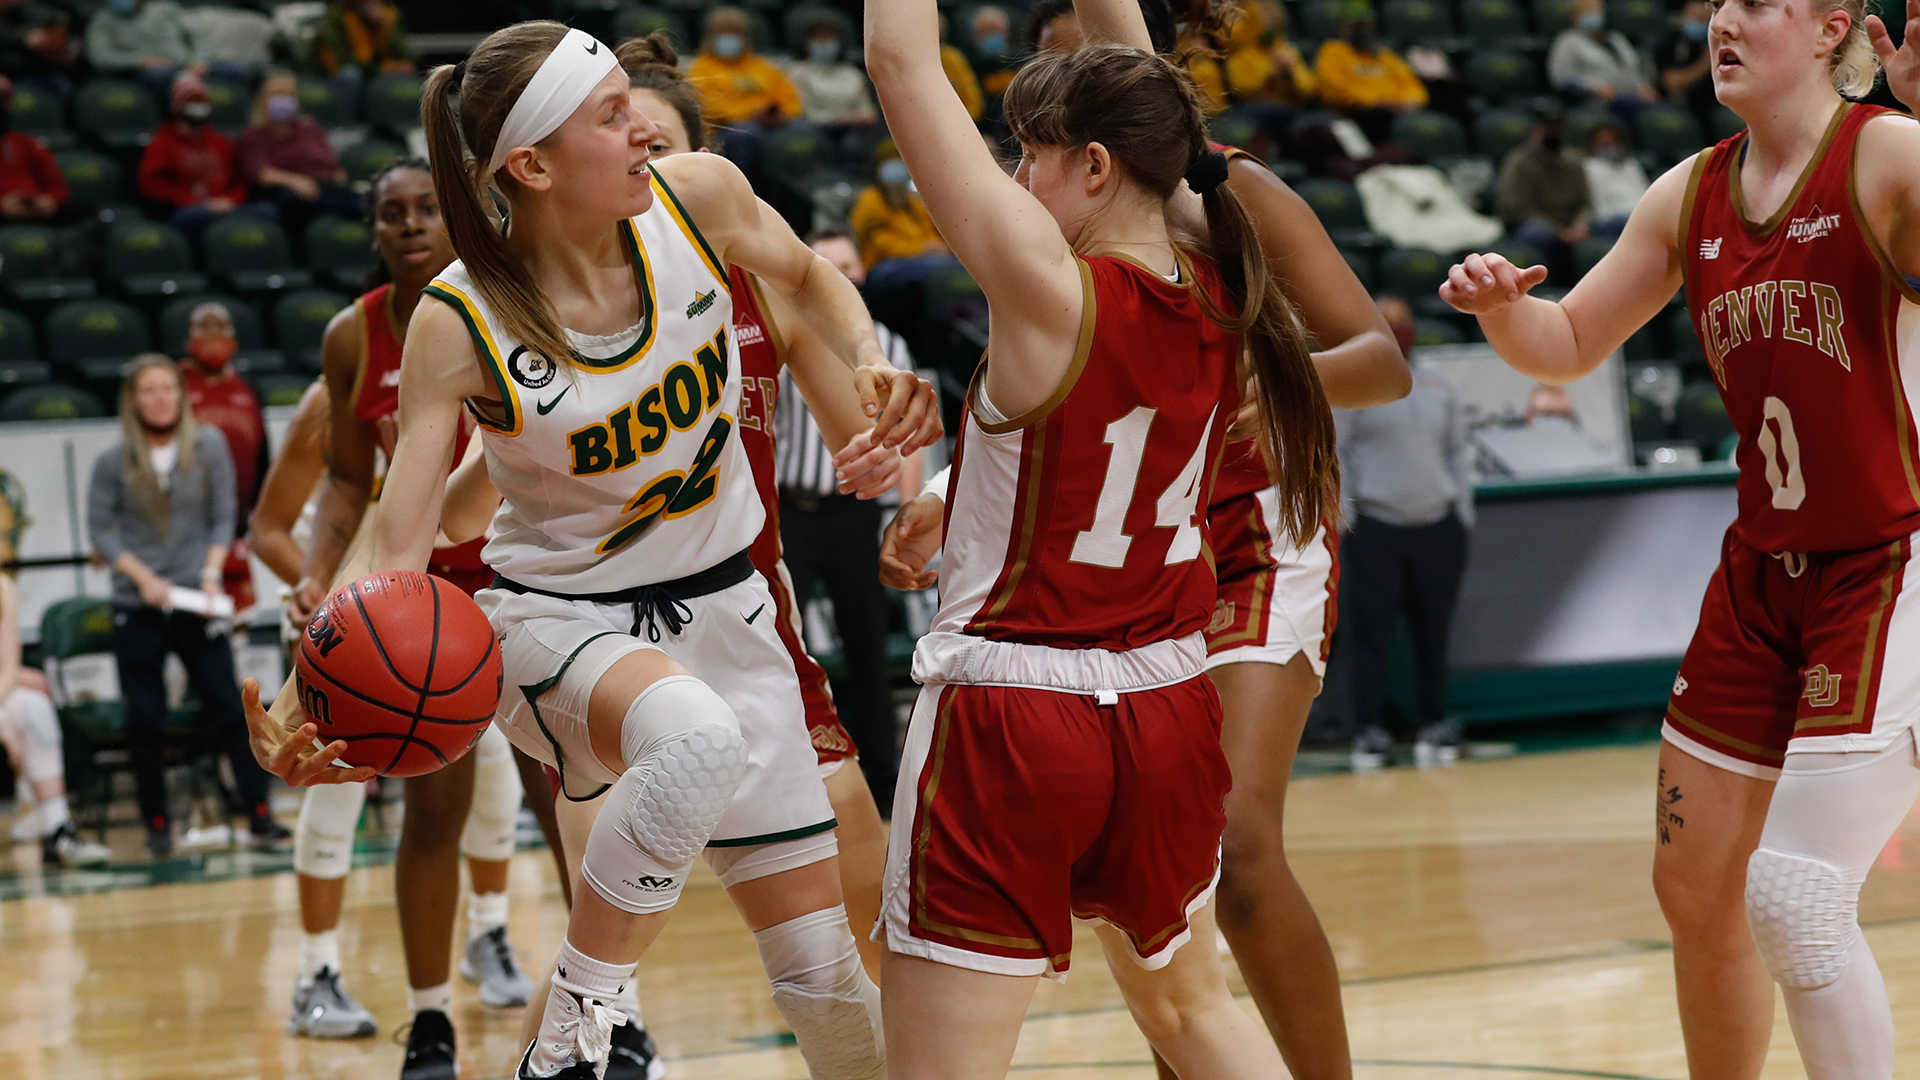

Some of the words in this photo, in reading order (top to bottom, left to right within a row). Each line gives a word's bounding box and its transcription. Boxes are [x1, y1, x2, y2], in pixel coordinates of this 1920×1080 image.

[685, 288, 717, 320] SUMMIT
[523, 379, 542, 388] United
[566, 321, 728, 477] BISON
[595, 412, 734, 554] 22
[1067, 400, 1220, 569] 14
[1758, 396, 1806, 511] 0
